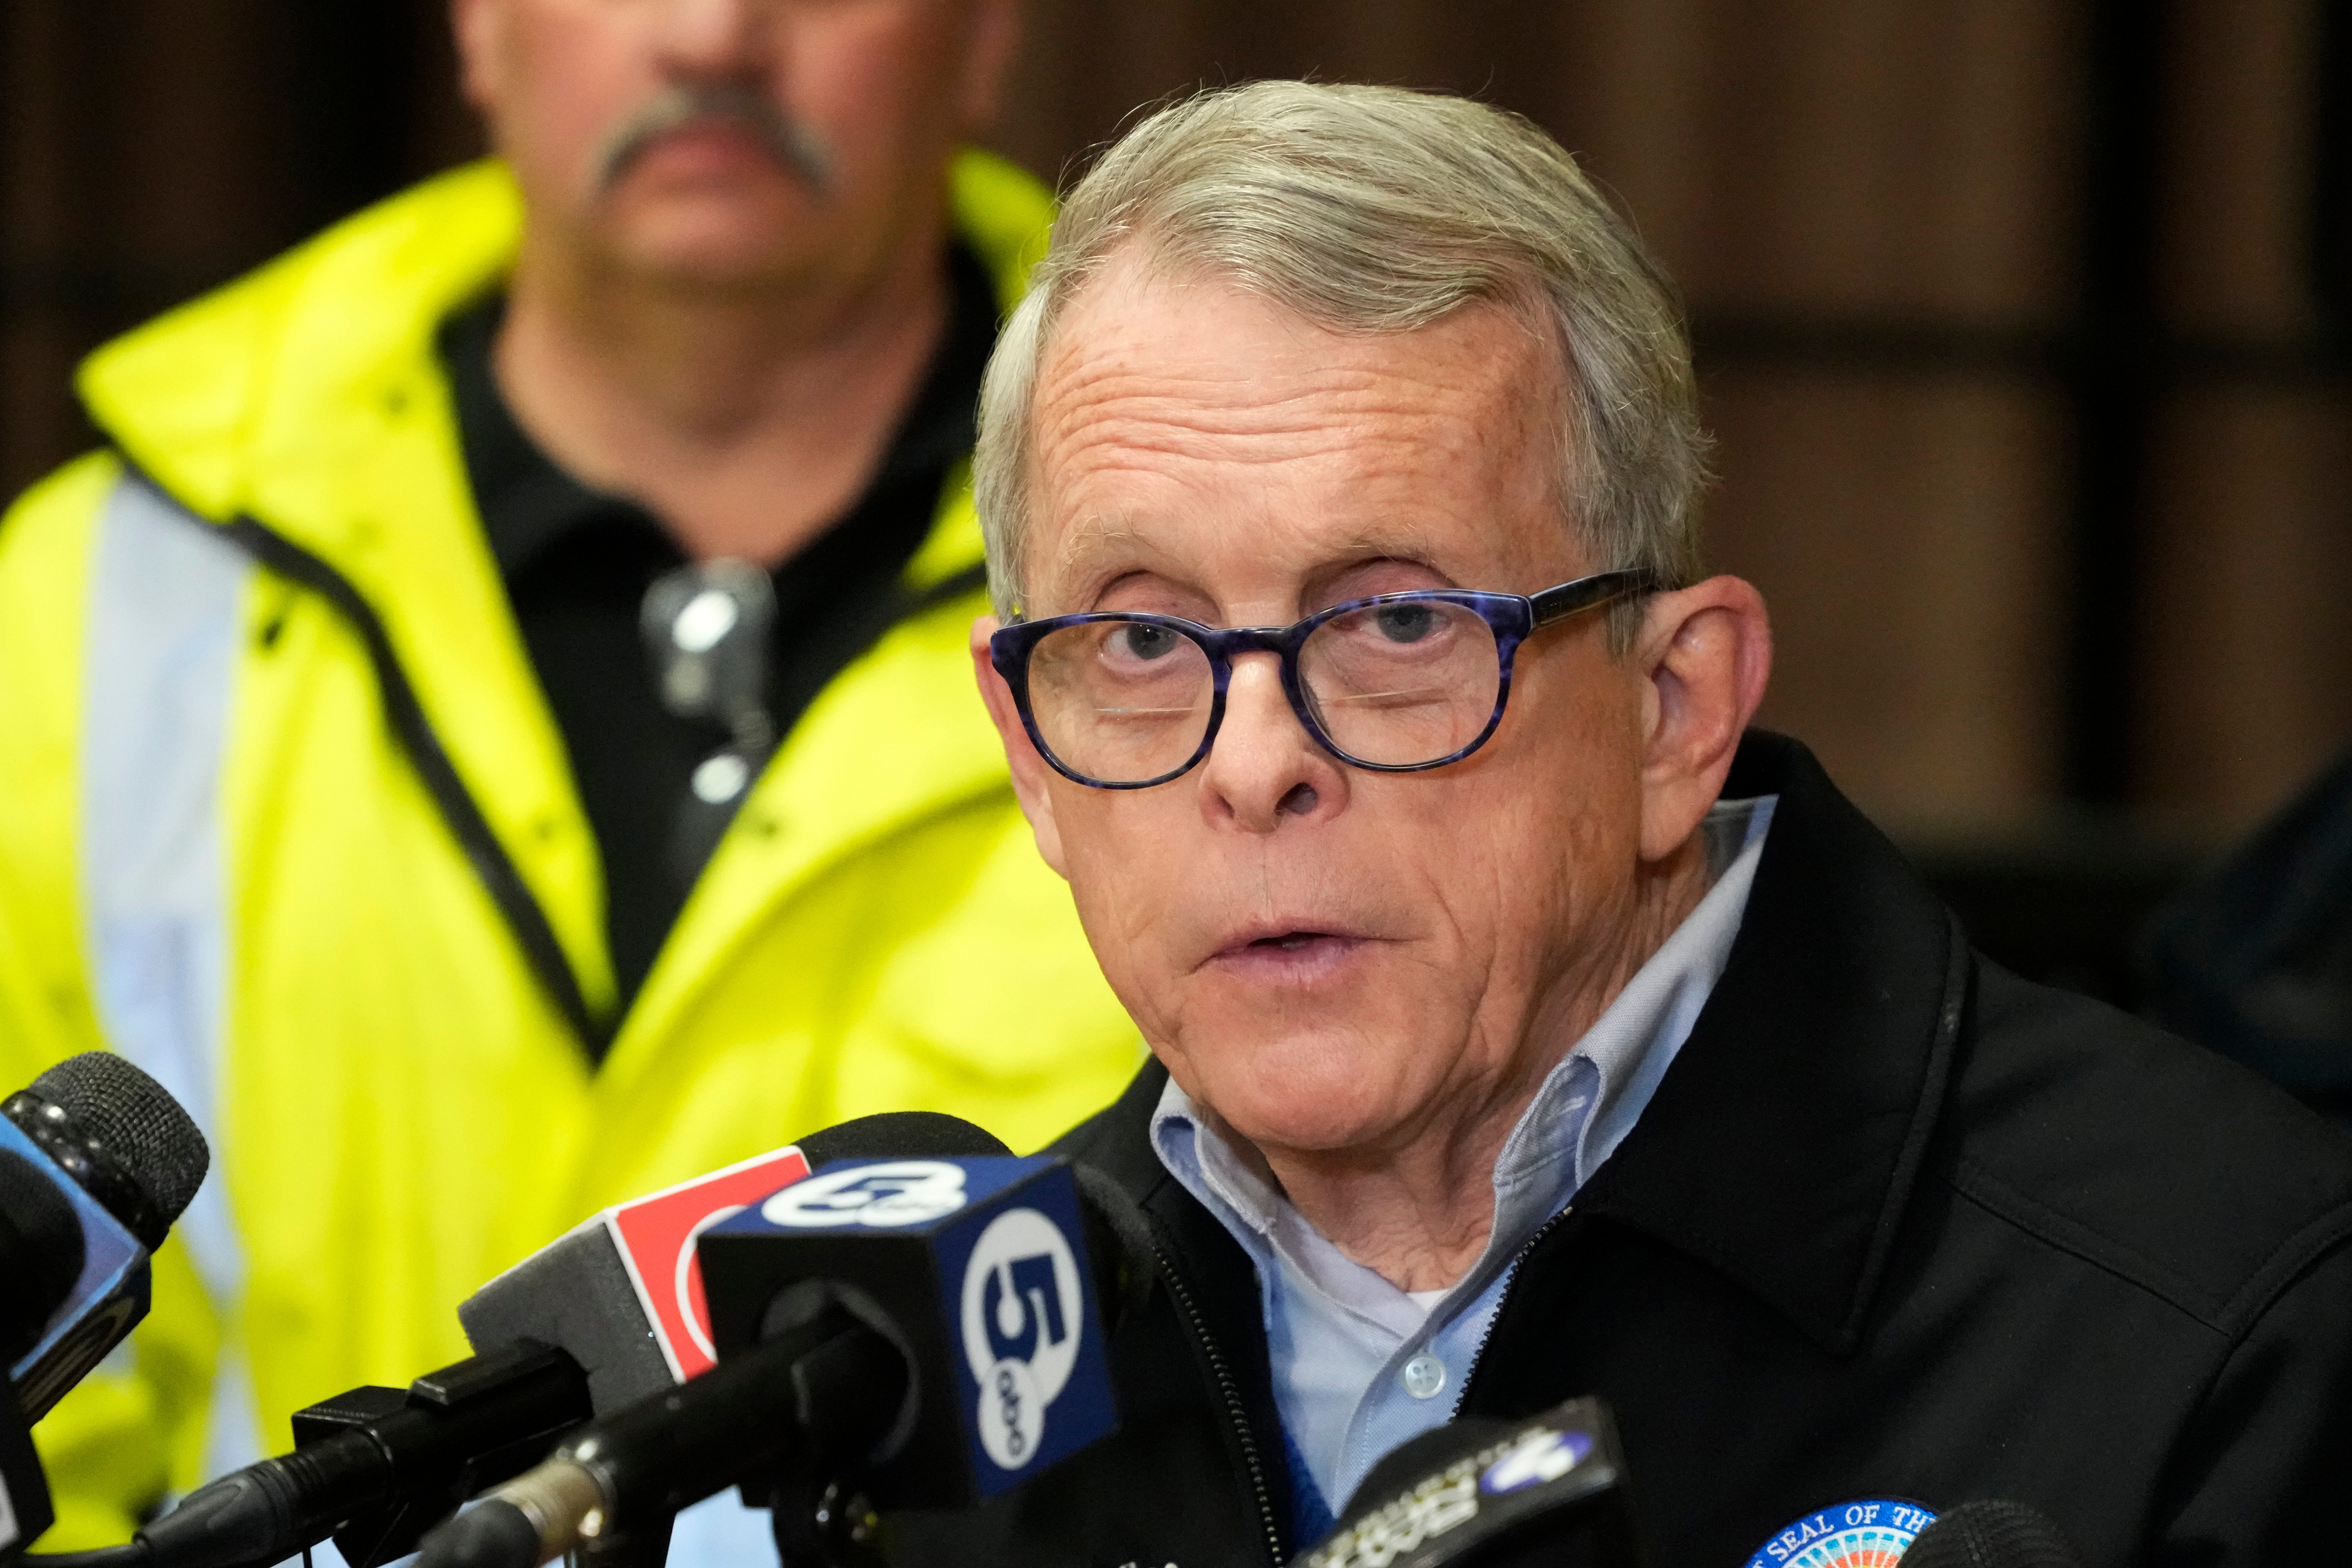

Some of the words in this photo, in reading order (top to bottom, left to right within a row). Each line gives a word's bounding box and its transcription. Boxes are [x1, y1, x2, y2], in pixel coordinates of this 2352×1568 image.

[982, 1252, 1068, 1363] 5
[1767, 1515, 1835, 1562] SEAL
[1845, 1505, 1880, 1526] OF
